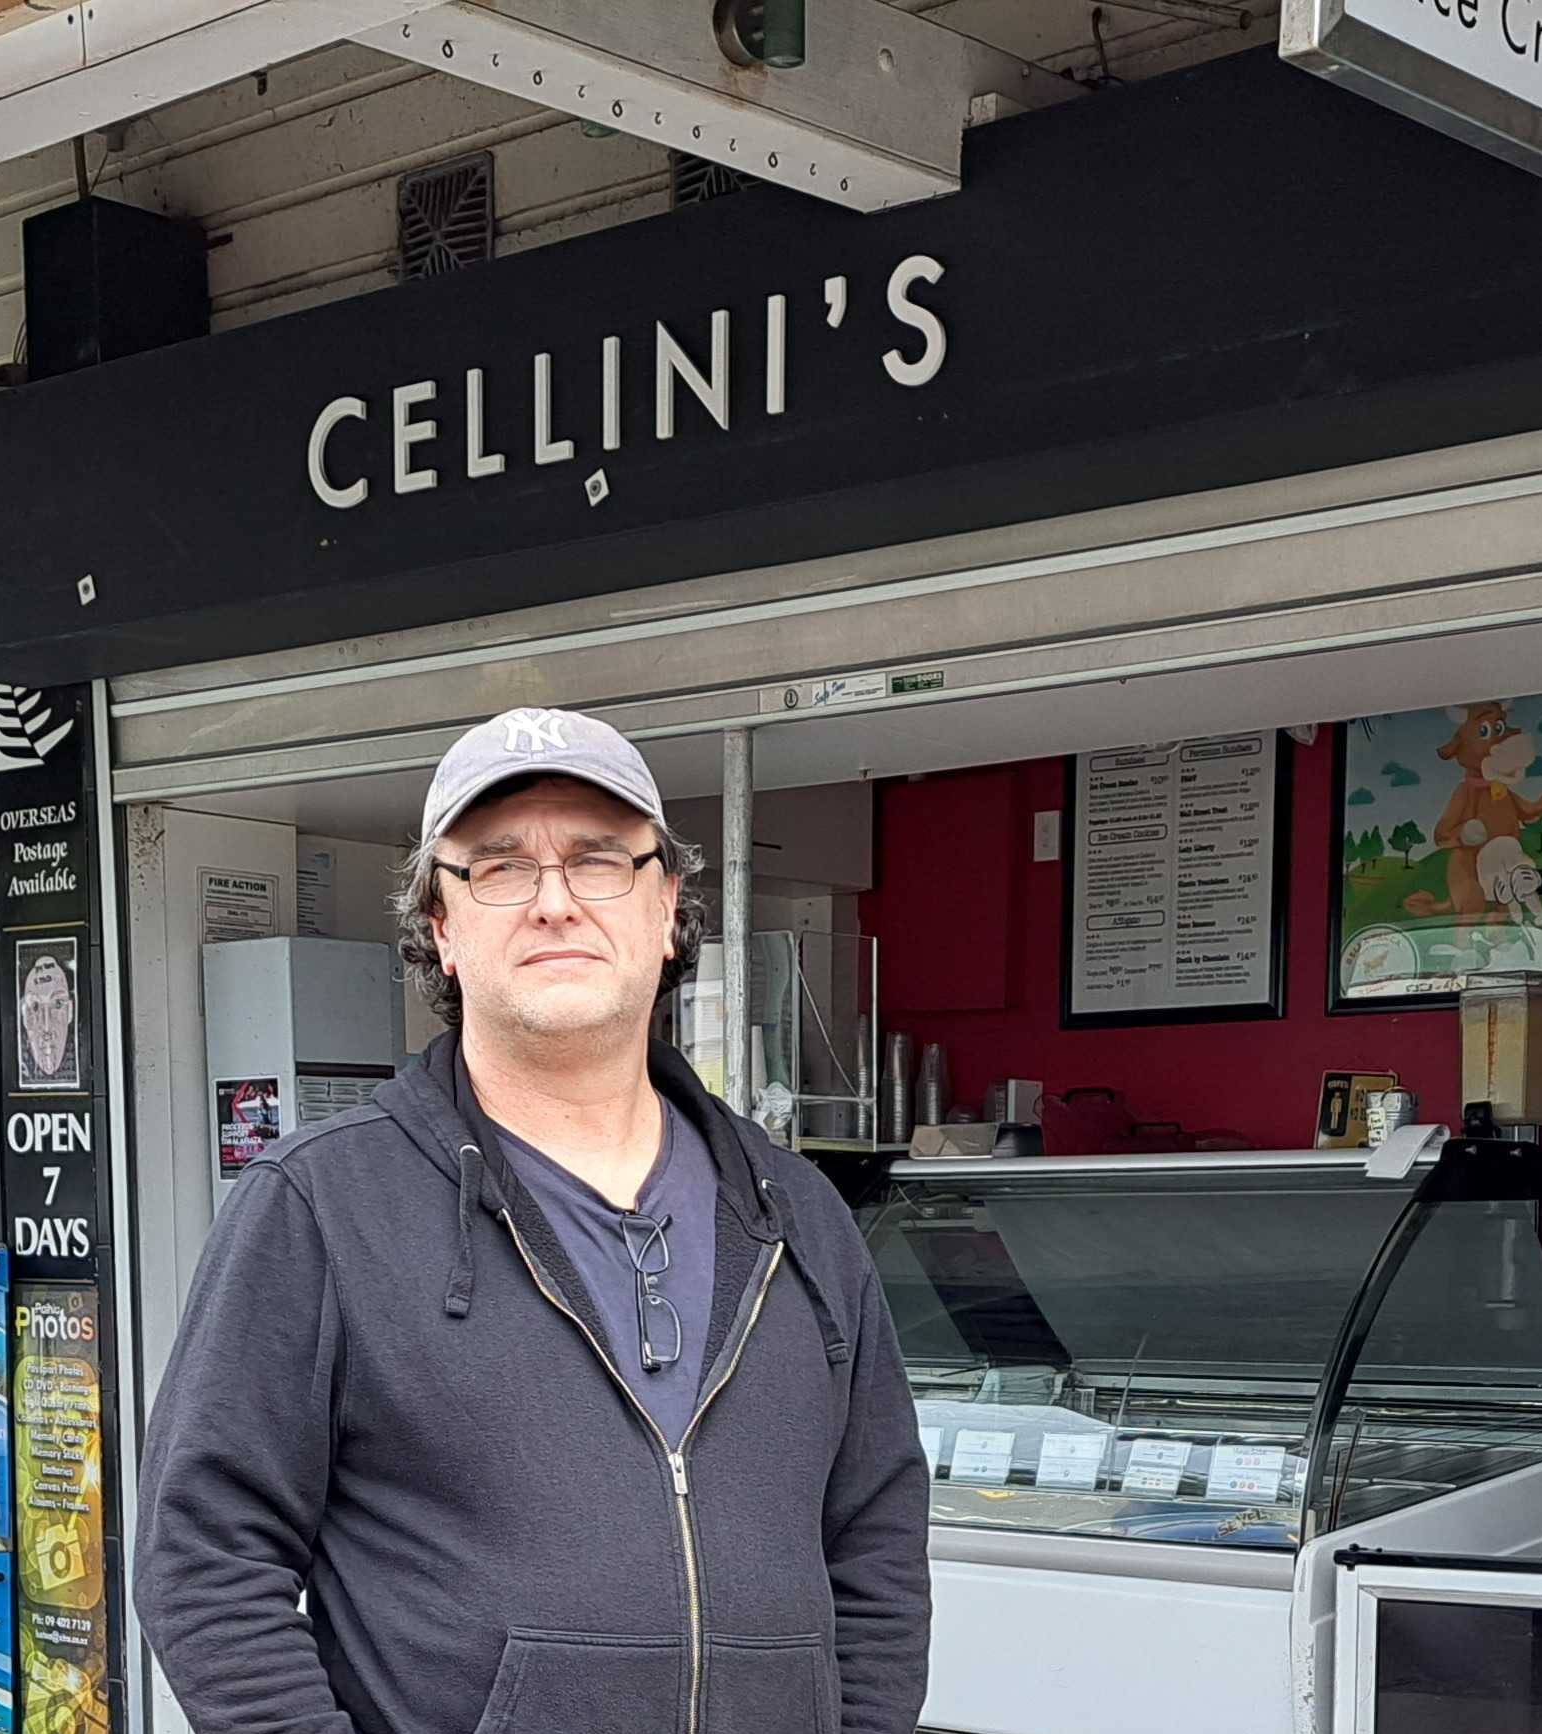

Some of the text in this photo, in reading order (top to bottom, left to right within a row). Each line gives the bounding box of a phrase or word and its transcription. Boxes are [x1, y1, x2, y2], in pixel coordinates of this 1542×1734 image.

[307, 254, 949, 511] CELLINI'S
[0, 801, 77, 832] OVERSEAS
[13, 840, 68, 867] Postage
[7, 867, 77, 897] Available
[208, 877, 267, 892] FIRE ACTION
[7, 1112, 91, 1153] OPEN
[42, 1166, 61, 1206] 7
[14, 1216, 90, 1258] DAYS
[15, 1306, 95, 1342] Photos
